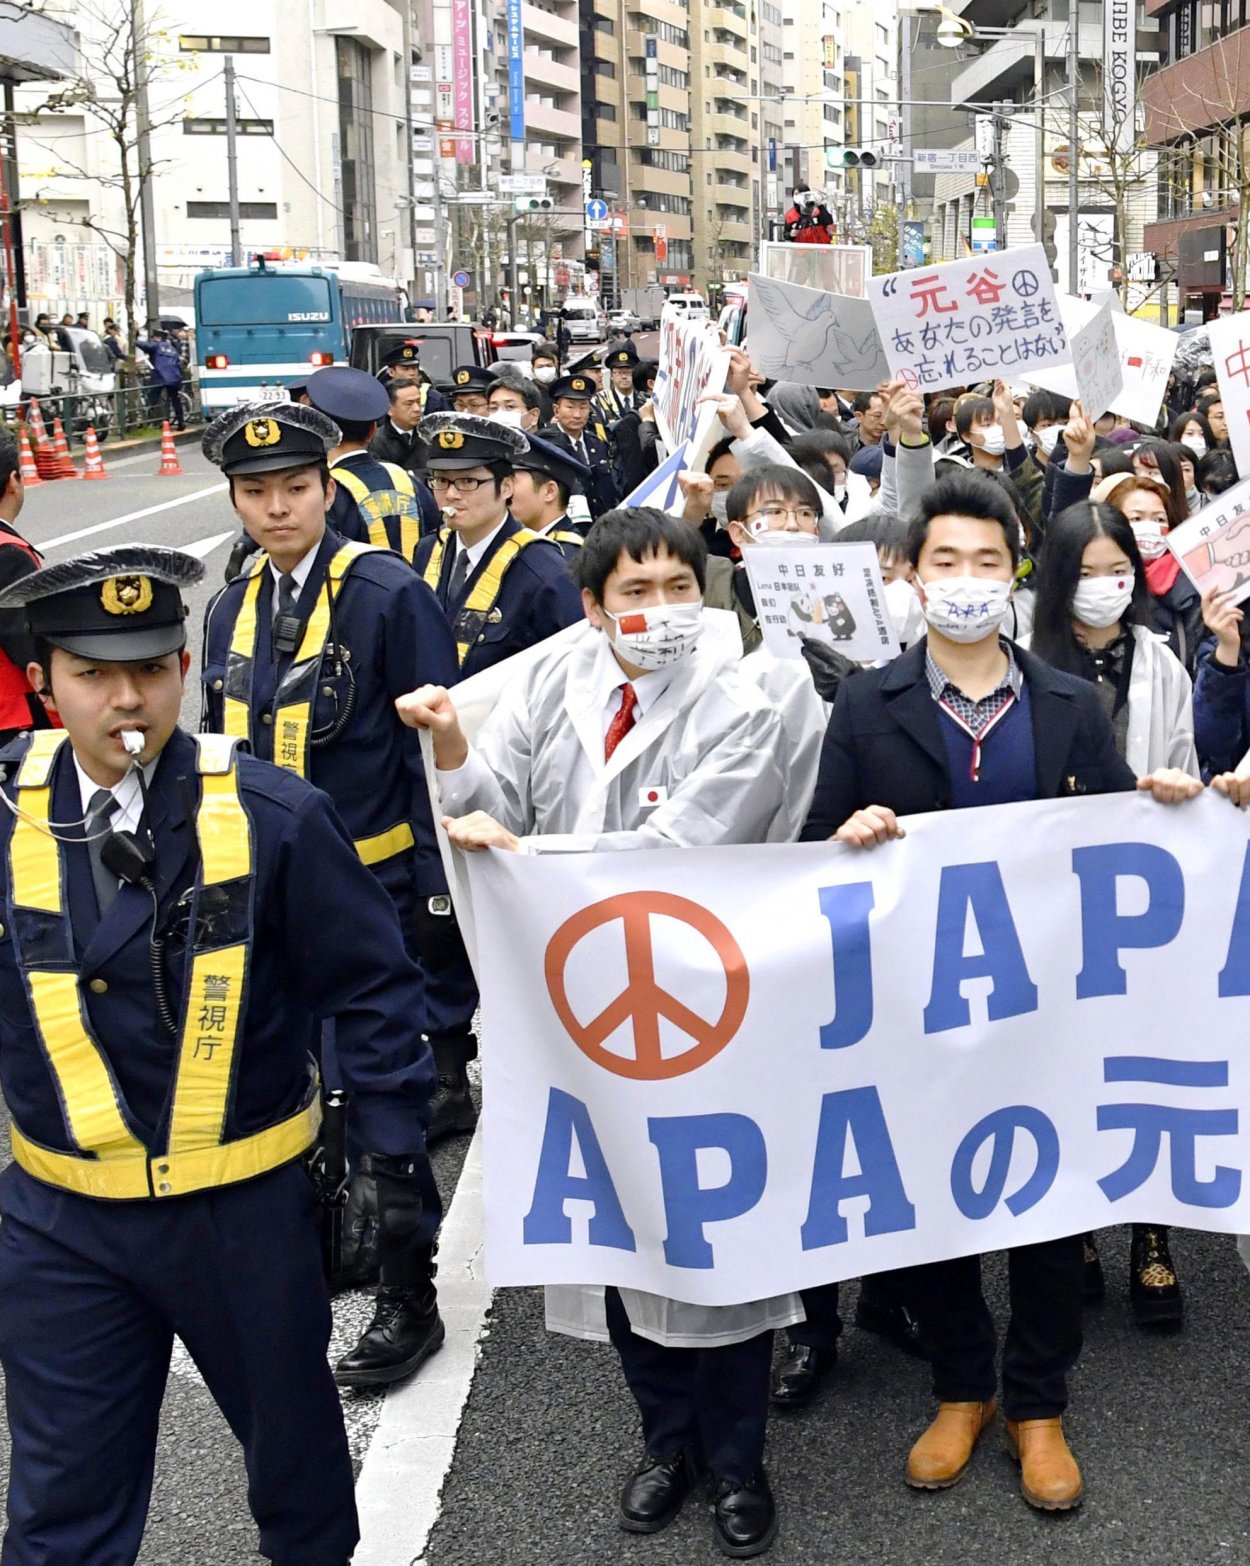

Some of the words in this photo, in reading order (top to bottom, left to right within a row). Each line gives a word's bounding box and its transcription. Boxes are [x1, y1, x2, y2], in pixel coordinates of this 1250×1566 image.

[288, 312, 329, 320] ISUZU
[891, 298, 1055, 355] あなたの発言を
[778, 563, 845, 577] 中日友好
[193, 974, 232, 1061] 警視庁
